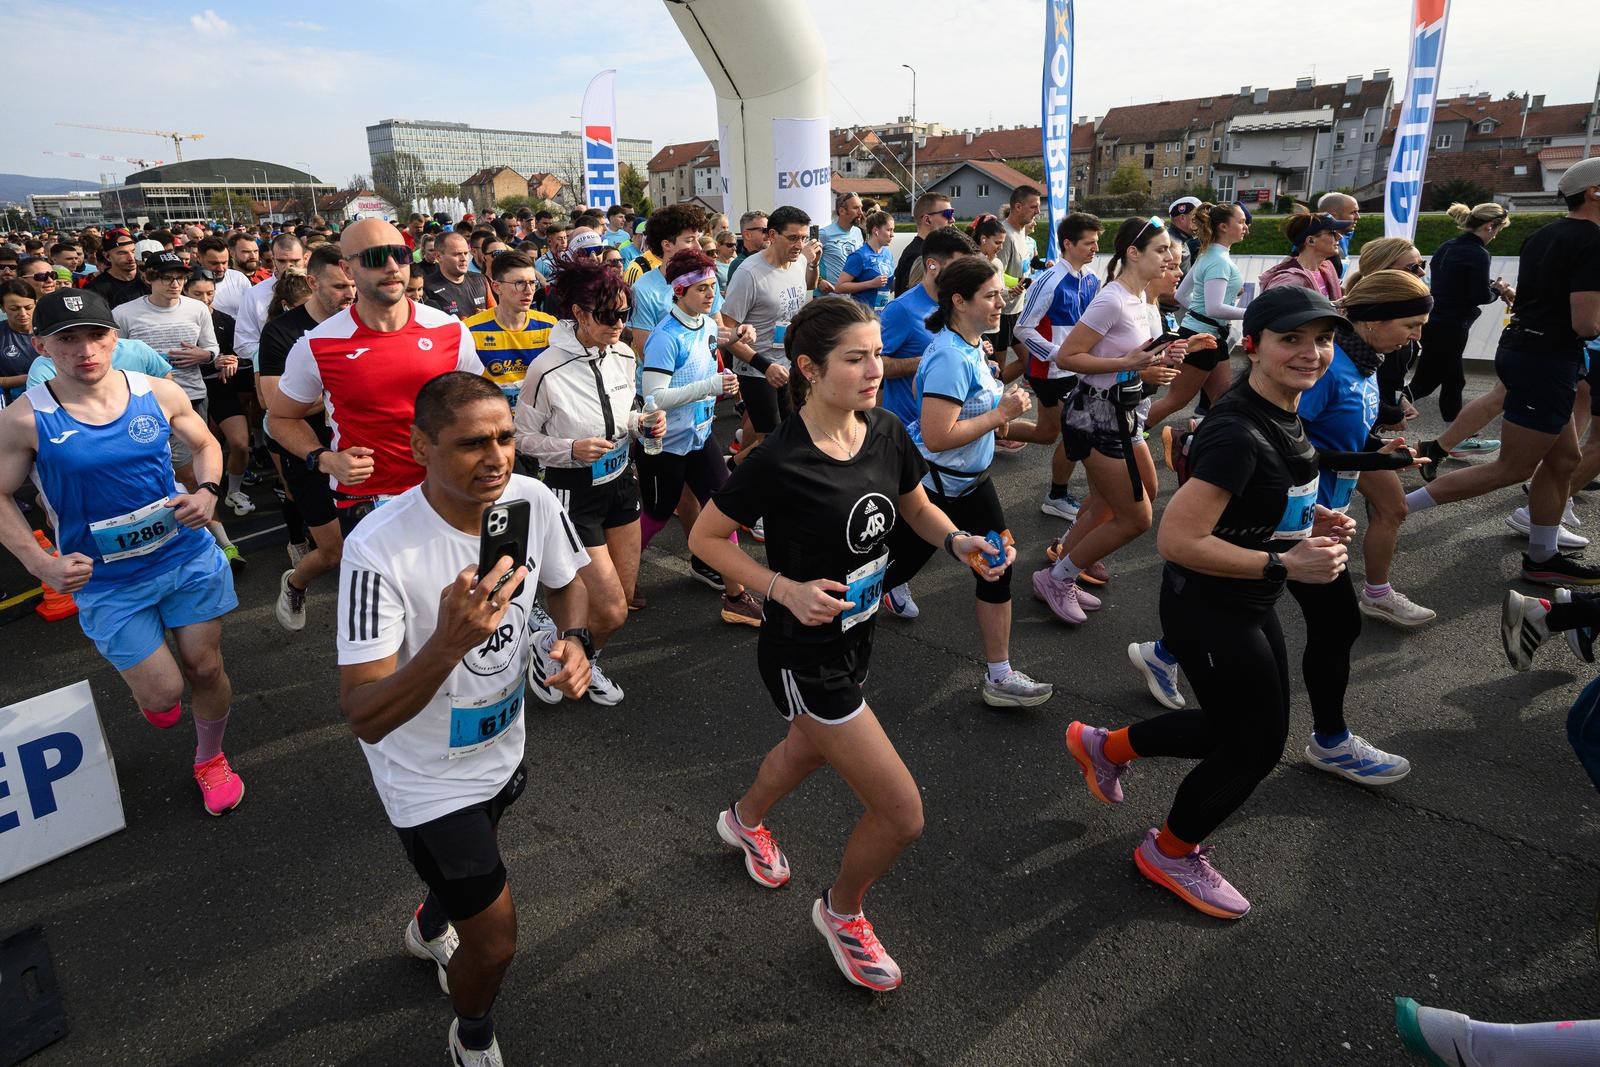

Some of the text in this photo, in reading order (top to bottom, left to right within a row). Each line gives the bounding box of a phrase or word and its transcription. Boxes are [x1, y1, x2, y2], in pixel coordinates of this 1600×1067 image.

[587, 164, 616, 210] HE
[778, 167, 830, 189] EXOTER
[115, 521, 165, 549] 1286
[481, 698, 519, 737] 619
